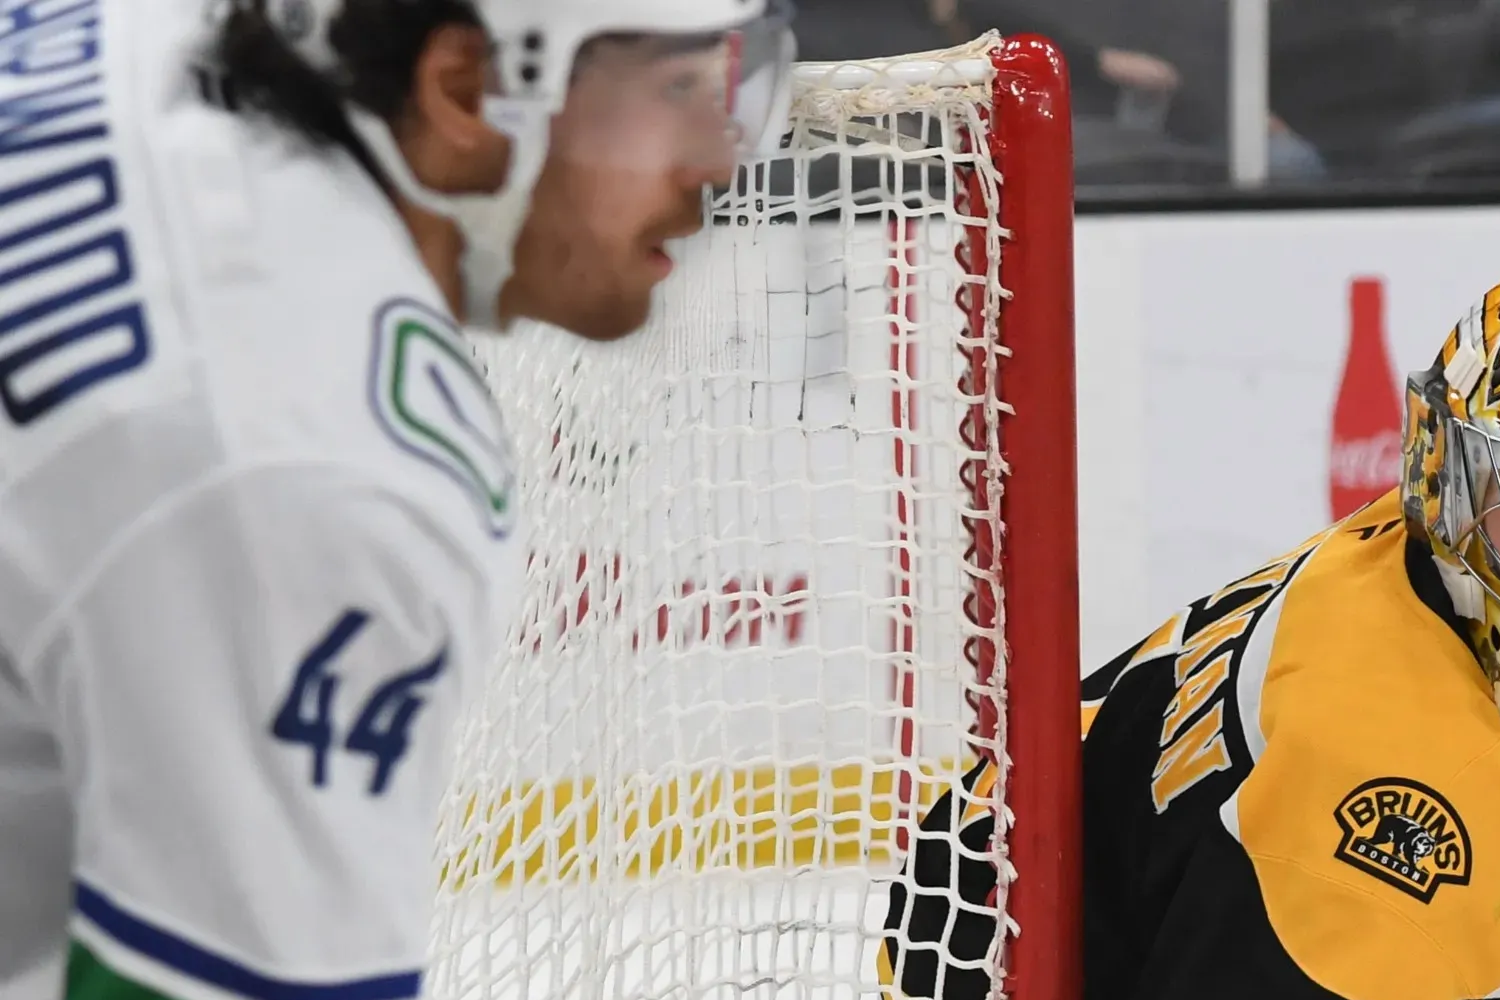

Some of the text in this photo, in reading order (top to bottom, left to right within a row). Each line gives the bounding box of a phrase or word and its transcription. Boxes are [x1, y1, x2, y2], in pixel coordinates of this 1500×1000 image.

[270, 607, 451, 797] 44
[1347, 790, 1461, 871] BRUINS
[1357, 843, 1421, 882] BOSTON
